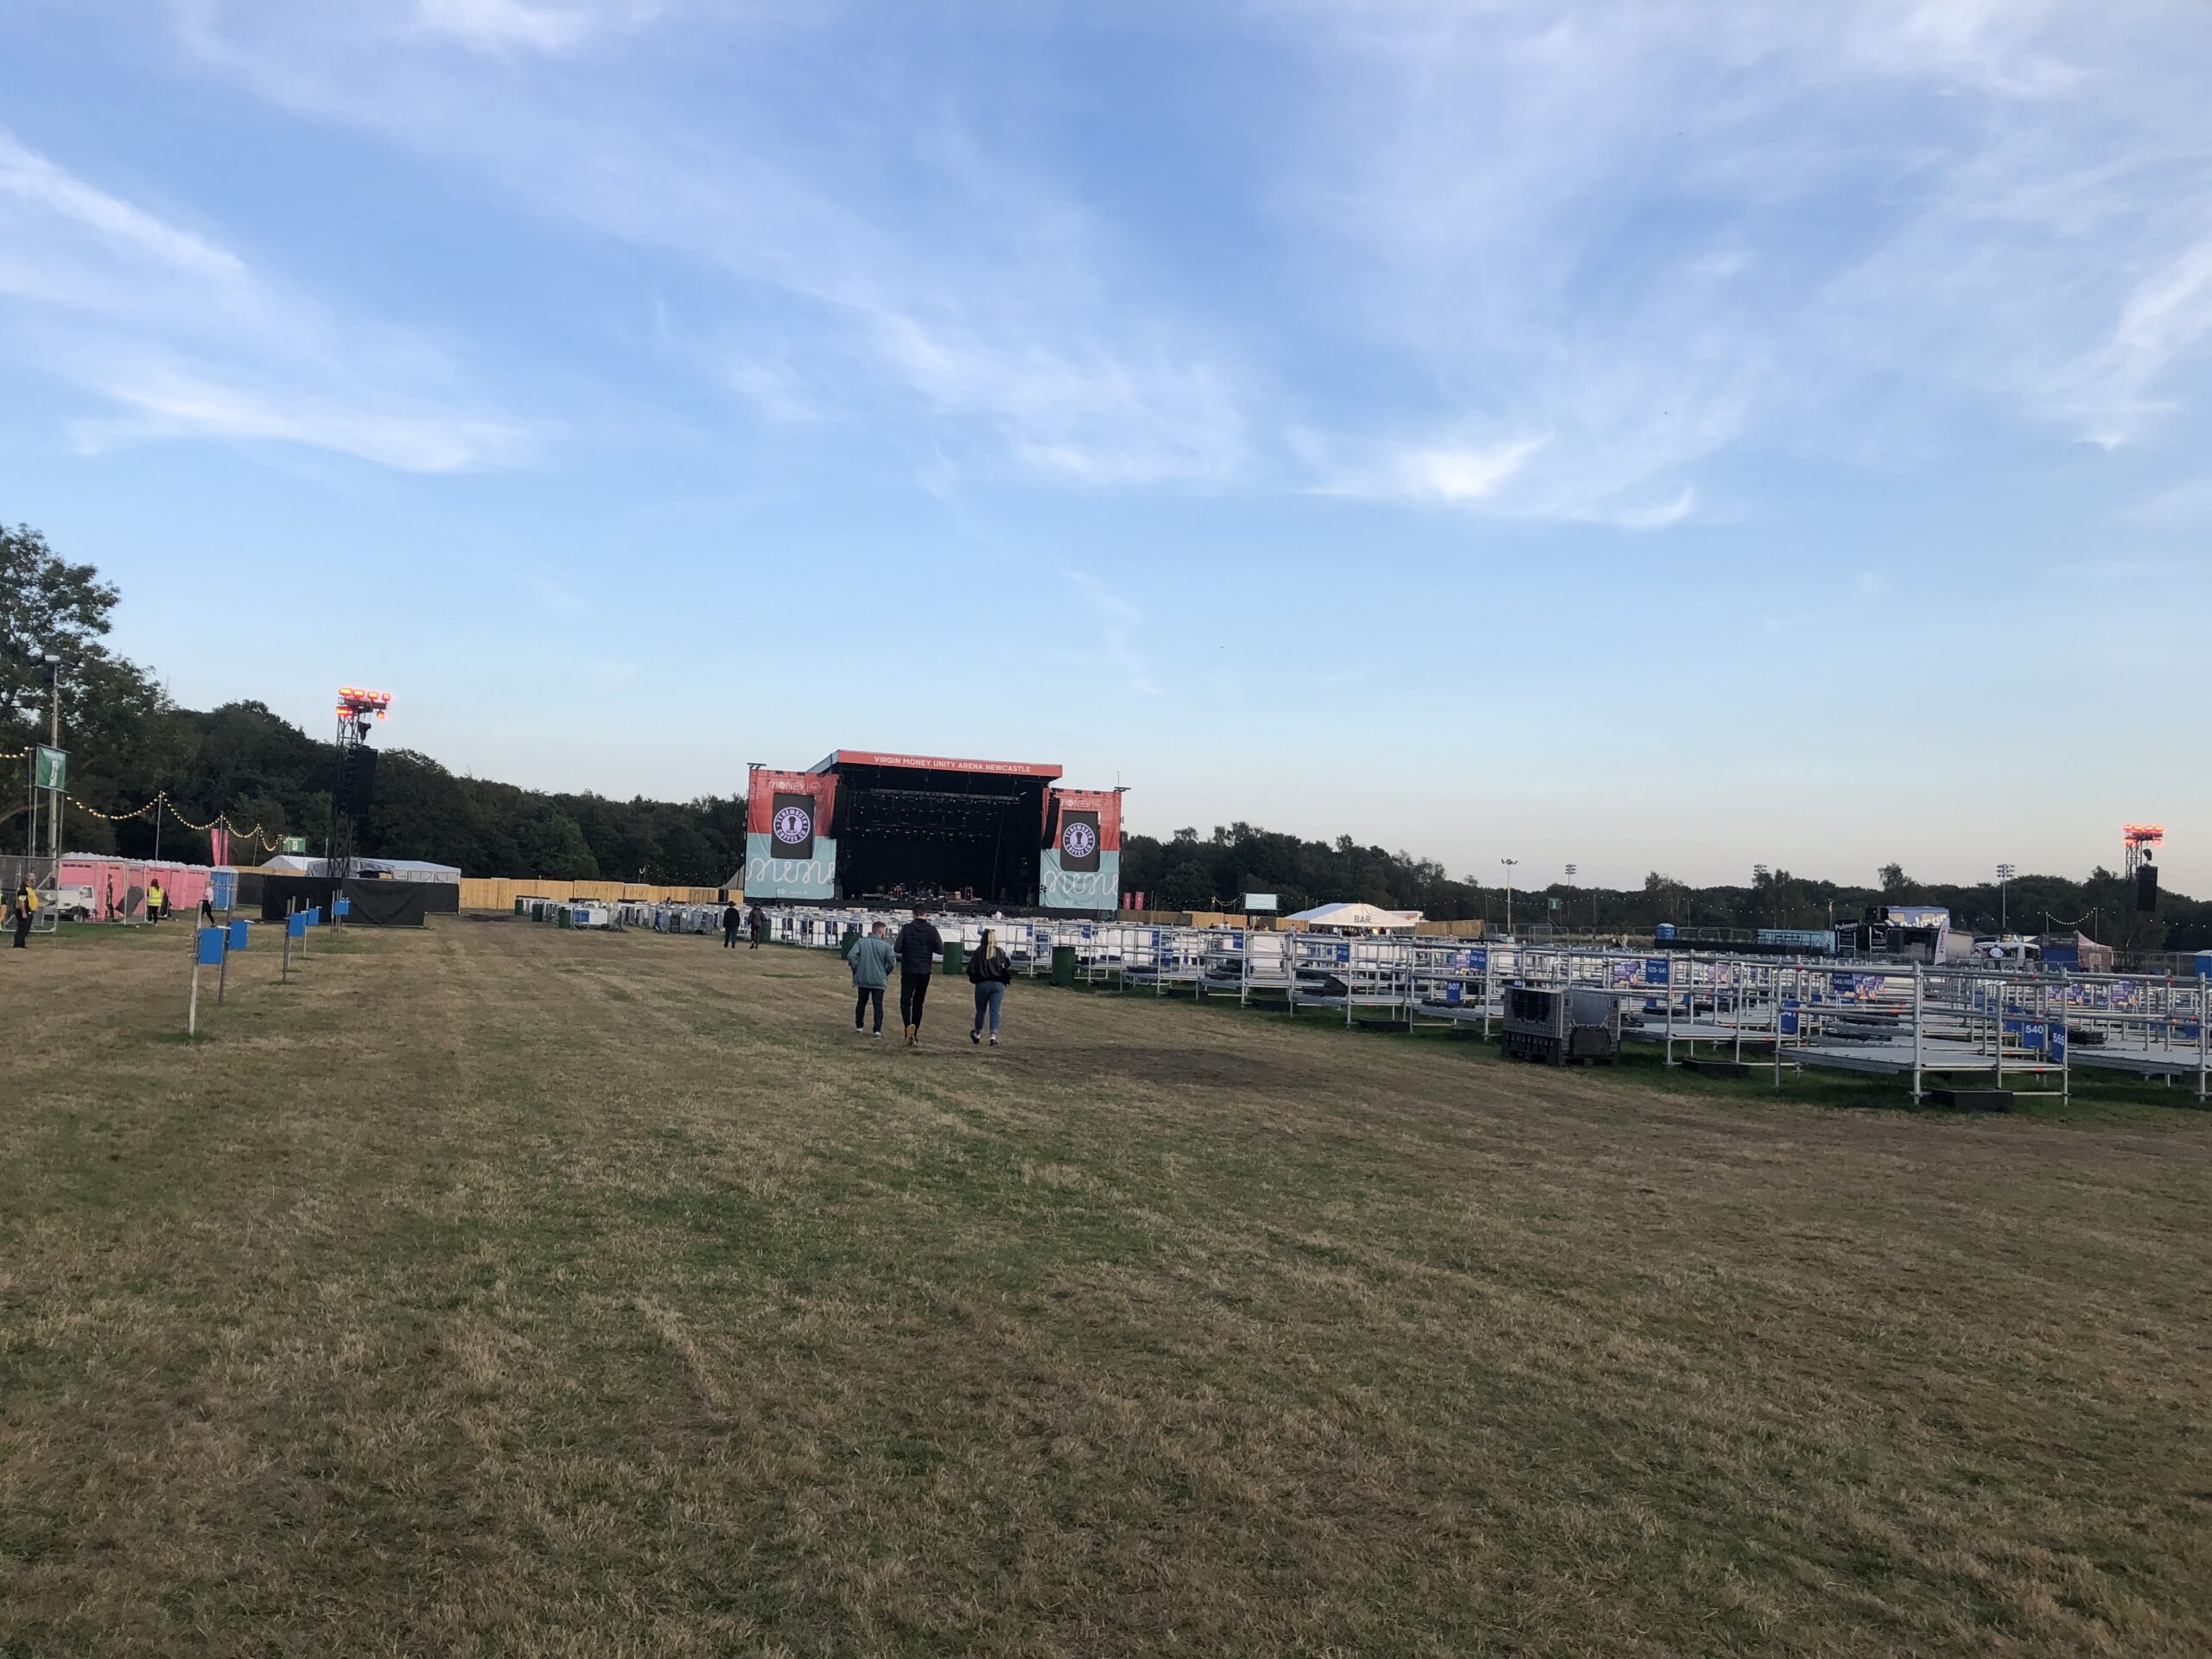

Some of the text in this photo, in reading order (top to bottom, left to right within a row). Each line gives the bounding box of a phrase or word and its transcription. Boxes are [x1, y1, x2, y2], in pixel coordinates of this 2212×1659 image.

[903, 758, 931, 766] MONEY
[985, 764, 1031, 772] NEWCASTLE
[776, 809, 809, 824] TYNEMOUTH
[777, 829, 798, 842] COFFEE
[1065, 824, 1093, 839] TYNEMOUTH
[1065, 843, 1084, 855] COFFEE
[1354, 915, 1371, 924] BAR
[1834, 922, 1858, 931] Pulman
[2025, 1025, 2044, 1034] 540
[2052, 1033, 2064, 1046] 555
